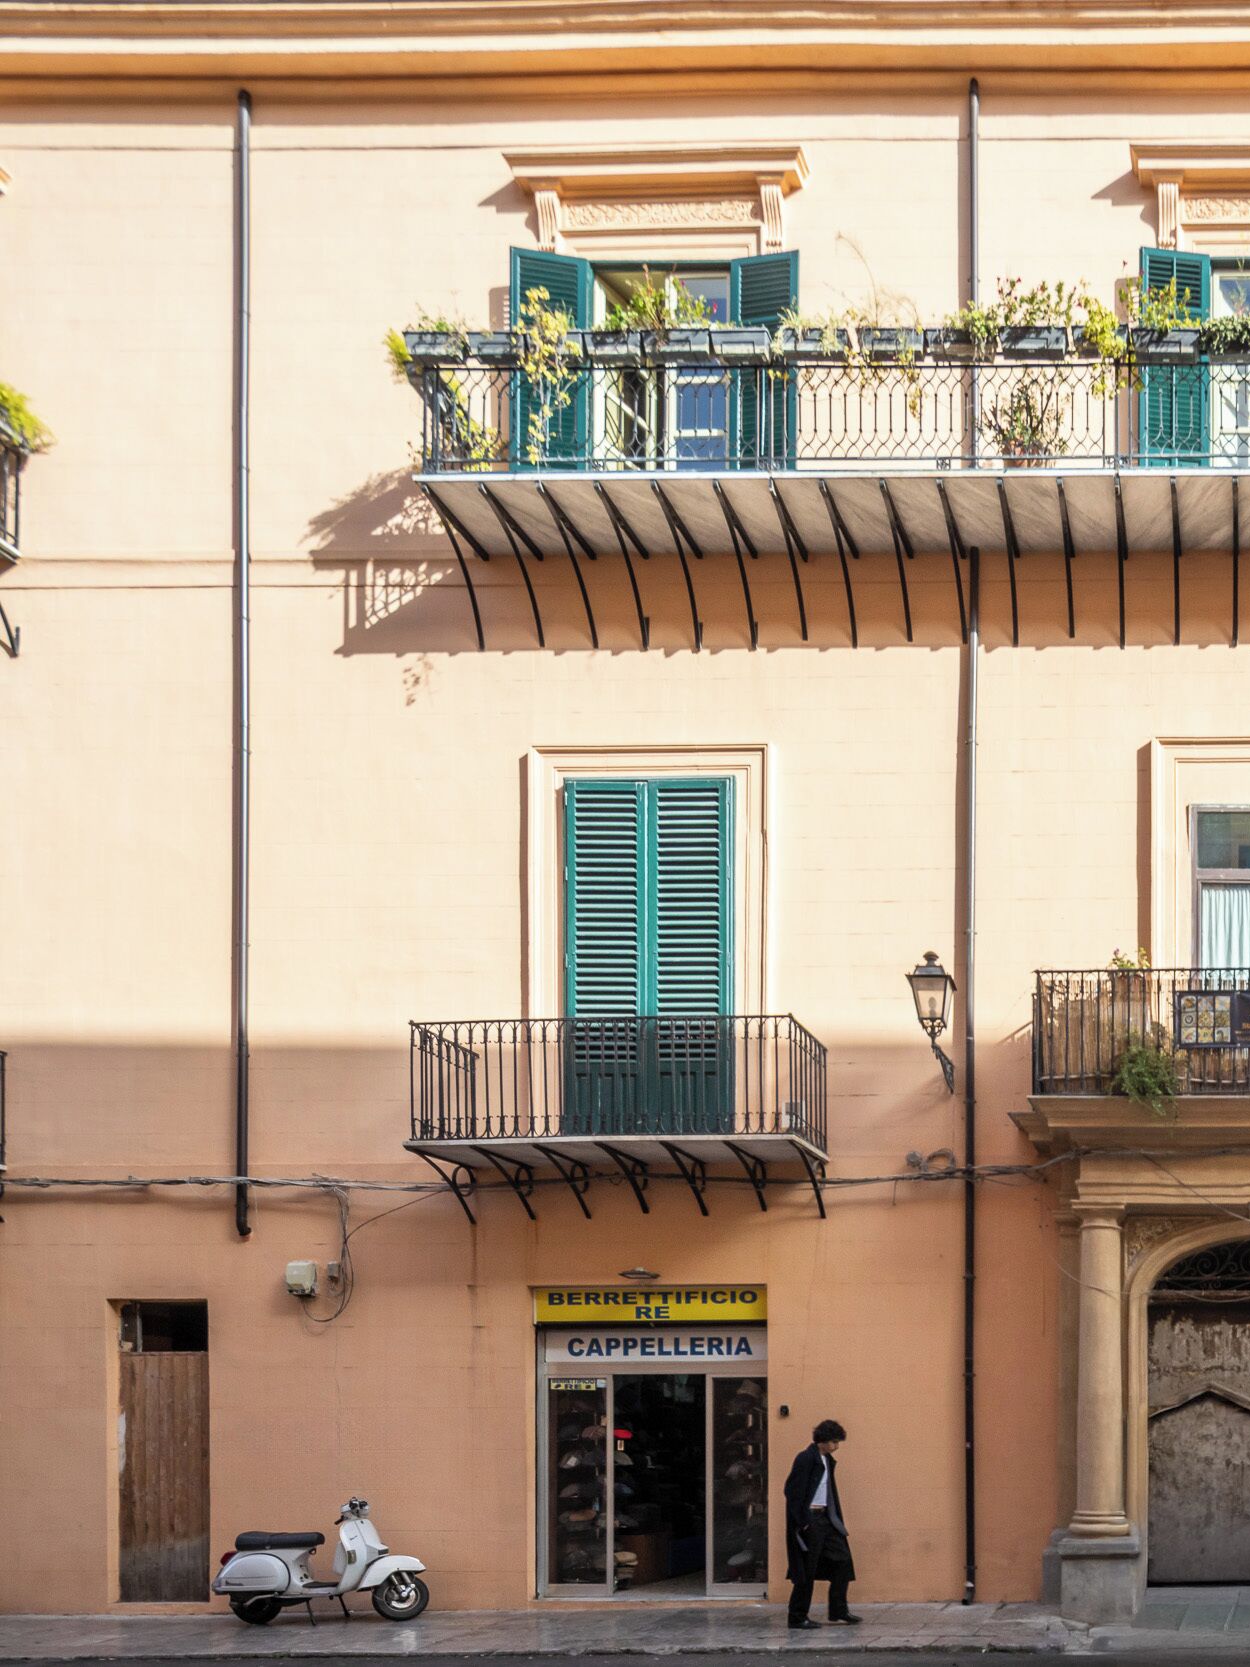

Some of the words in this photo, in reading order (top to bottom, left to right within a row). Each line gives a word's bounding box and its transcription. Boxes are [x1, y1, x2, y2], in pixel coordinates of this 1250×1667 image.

[548, 1290, 758, 1306] BERRETTIFICIO
[635, 1306, 670, 1319] RE
[567, 1336, 753, 1357] CAPPELLERIA
